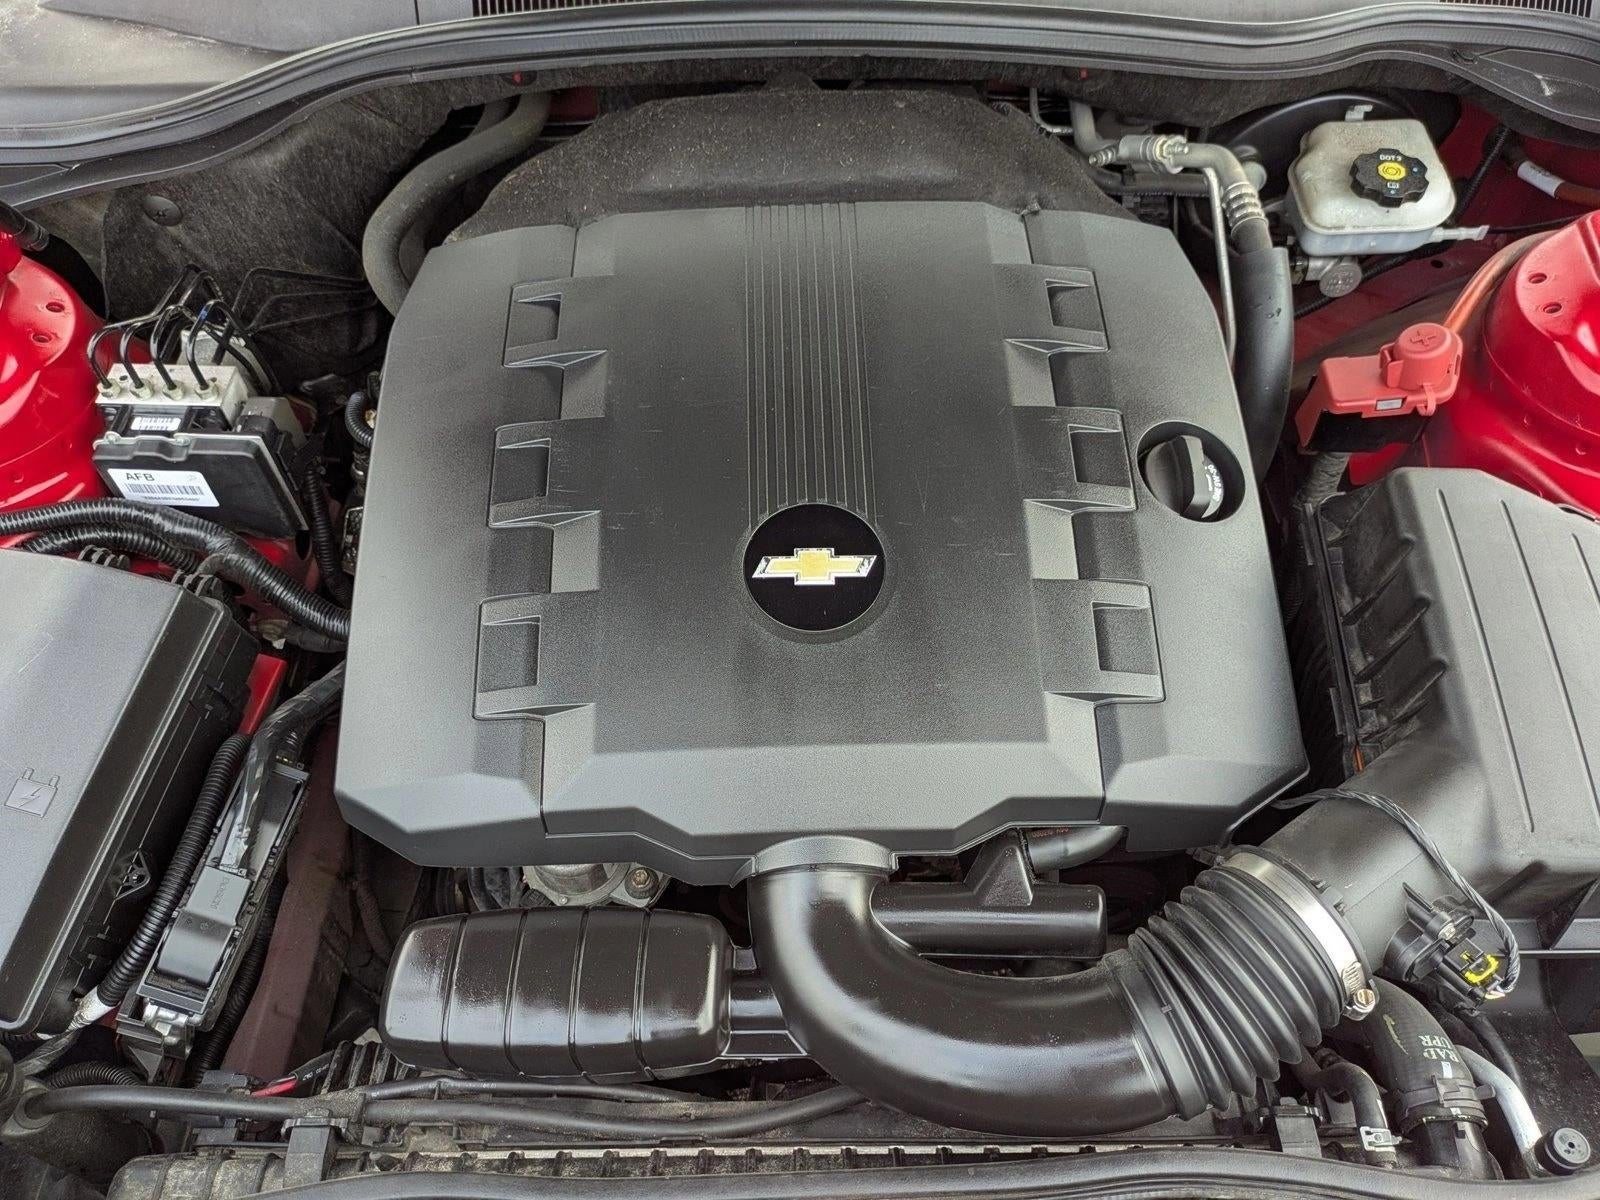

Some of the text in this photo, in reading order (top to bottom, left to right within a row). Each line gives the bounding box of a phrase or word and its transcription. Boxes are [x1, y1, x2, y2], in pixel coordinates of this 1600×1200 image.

[125, 472, 155, 482] AFB
[1418, 1034, 1452, 1049] UPR
[1422, 1047, 1460, 1062] RAD
